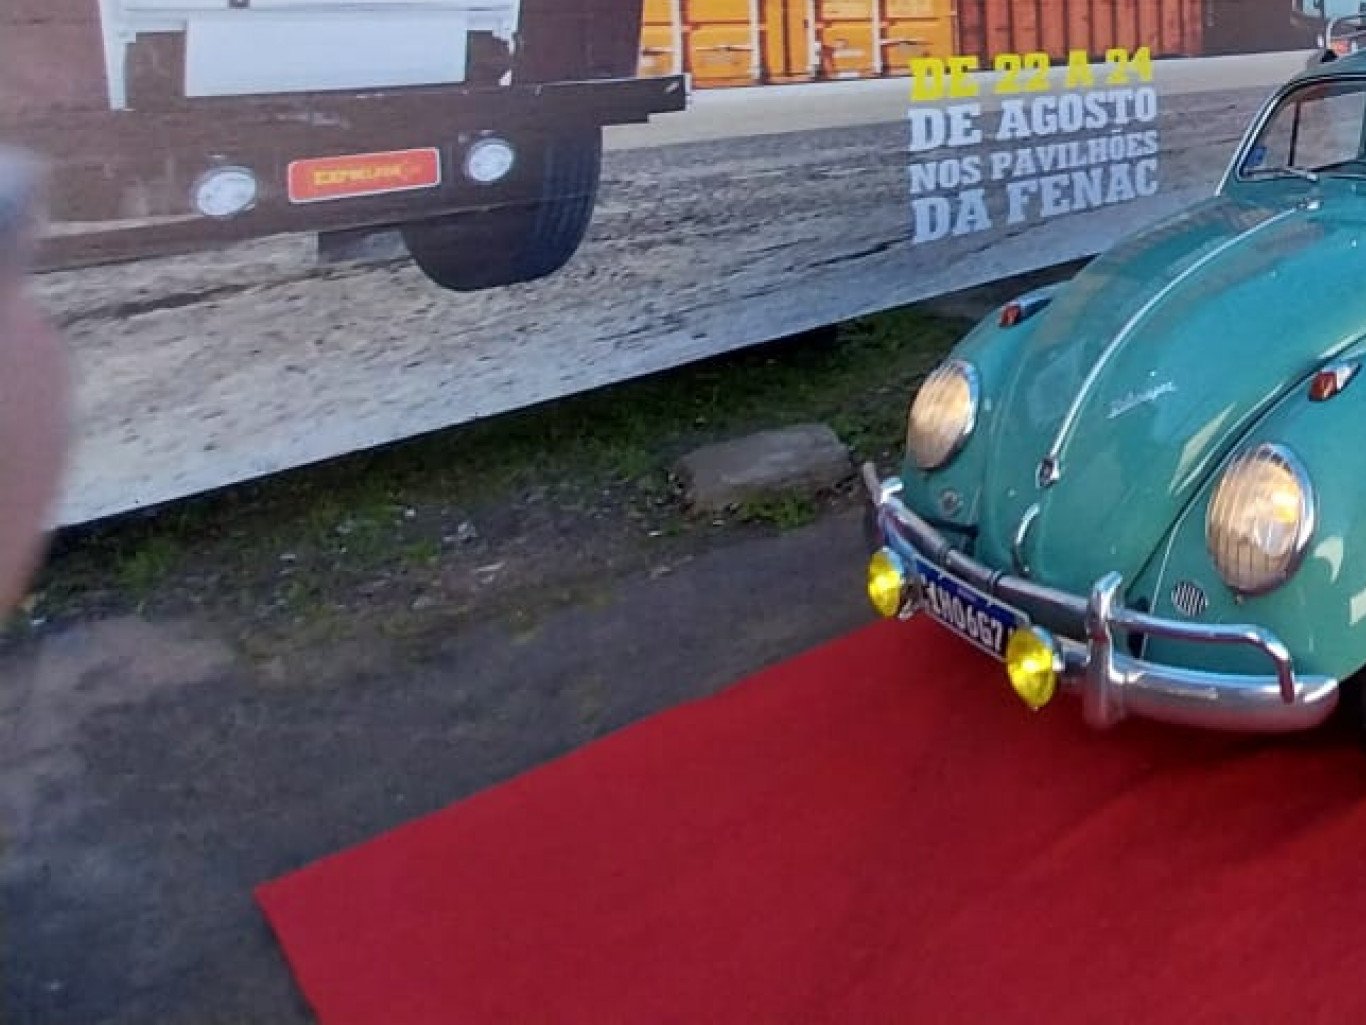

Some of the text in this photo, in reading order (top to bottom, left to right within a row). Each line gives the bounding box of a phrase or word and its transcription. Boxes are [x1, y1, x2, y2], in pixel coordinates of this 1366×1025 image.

[908, 46, 1154, 101] DE 22 A 24
[908, 88, 1158, 152] DE AGOSTO
[908, 129, 1159, 195] NOS PAVILHÕES
[911, 158, 1159, 244] DA FENAC
